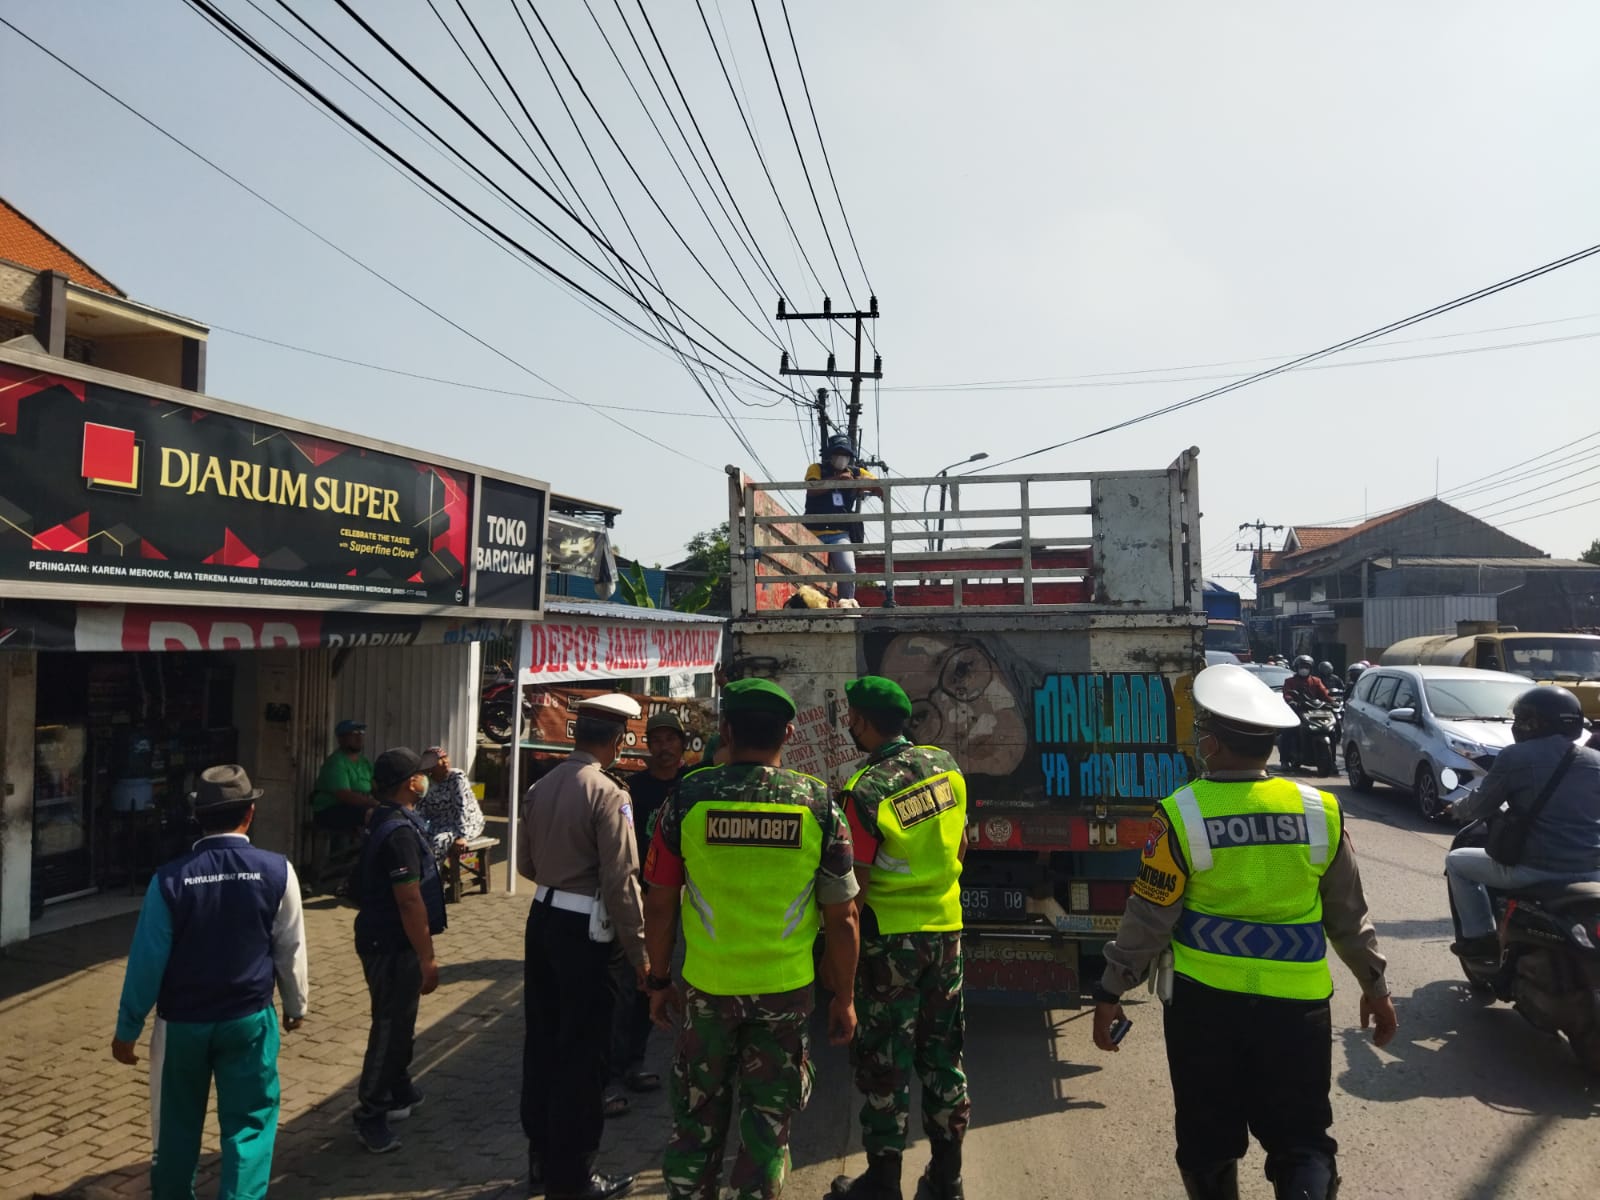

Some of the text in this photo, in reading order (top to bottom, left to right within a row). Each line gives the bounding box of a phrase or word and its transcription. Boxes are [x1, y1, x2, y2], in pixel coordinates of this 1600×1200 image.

[160, 447, 401, 523] DJARUM SUPER
[340, 528, 411, 545] CELEBRATE THE TASTE
[349, 541, 391, 556] Superfine
[476, 515, 535, 575] TOKO BAROKAH
[29, 560, 90, 573] PERINGATAN:
[92, 565, 127, 576] KARENA
[129, 568, 172, 580] MEROKOK,
[173, 572, 192, 580] SAYA
[194, 573, 228, 583] TERKENA
[229, 575, 258, 585] KANKER
[311, 582, 337, 591] LAYANAN
[529, 624, 599, 674] DEPOT
[604, 626, 648, 671] JAMU
[1034, 674, 1168, 744] MAULANA
[1041, 752, 1071, 797] YA
[1206, 815, 1306, 845] POLISI
